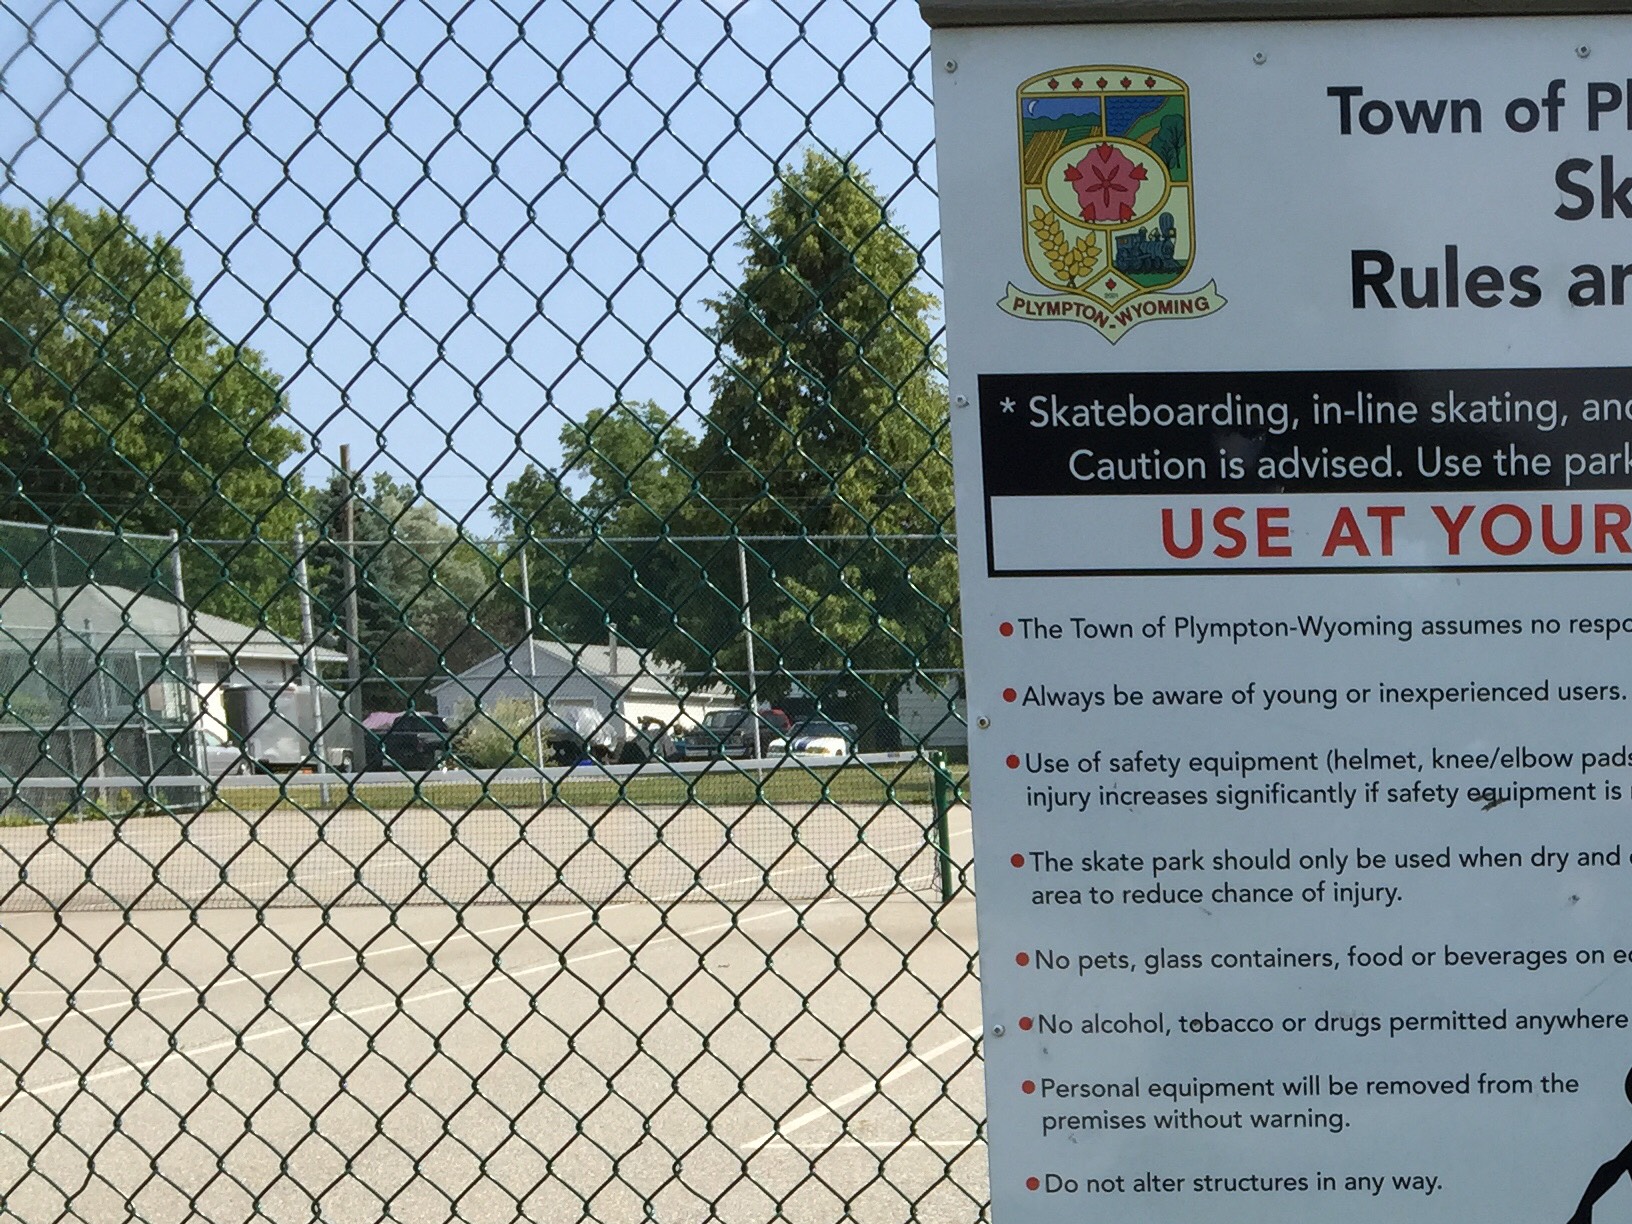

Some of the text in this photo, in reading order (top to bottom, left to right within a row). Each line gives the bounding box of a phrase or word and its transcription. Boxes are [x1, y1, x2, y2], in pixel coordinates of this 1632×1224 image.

[1327, 86, 1482, 135] Town
[1505, 79, 1566, 133] of
[1351, 245, 1541, 309] Rules
[1030, 393, 1298, 434] Skateboarding,
[1313, 391, 1417, 424] in-line
[1431, 390, 1568, 431] skating,
[1069, 449, 1205, 480] Caution
[1220, 448, 1244, 479] is
[1258, 445, 1402, 478] advised.
[1418, 446, 1482, 477] Use
[1493, 443, 1551, 476] the
[1162, 507, 1292, 559] USE
[1322, 506, 1405, 556] AT
[1431, 504, 1632, 555] YOUR
[1018, 617, 1062, 639] The
[1070, 618, 1132, 638] Town
[1142, 616, 1166, 638] of
[1175, 615, 1412, 644] Plympton-Wyoming
[1422, 620, 1522, 635] assumes
[1532, 619, 1560, 634] no
[1036, 950, 1069, 969] No
[1079, 952, 1135, 976] pets,
[1145, 948, 1202, 974] glass
[1211, 948, 1339, 970] containers,
[1347, 945, 1402, 966] food
[1412, 952, 1436, 966] or
[1445, 945, 1567, 970] beverages
[1576, 950, 1604, 964] on
[1045, 1172, 1442, 1196] Do not alter structures in any way.
